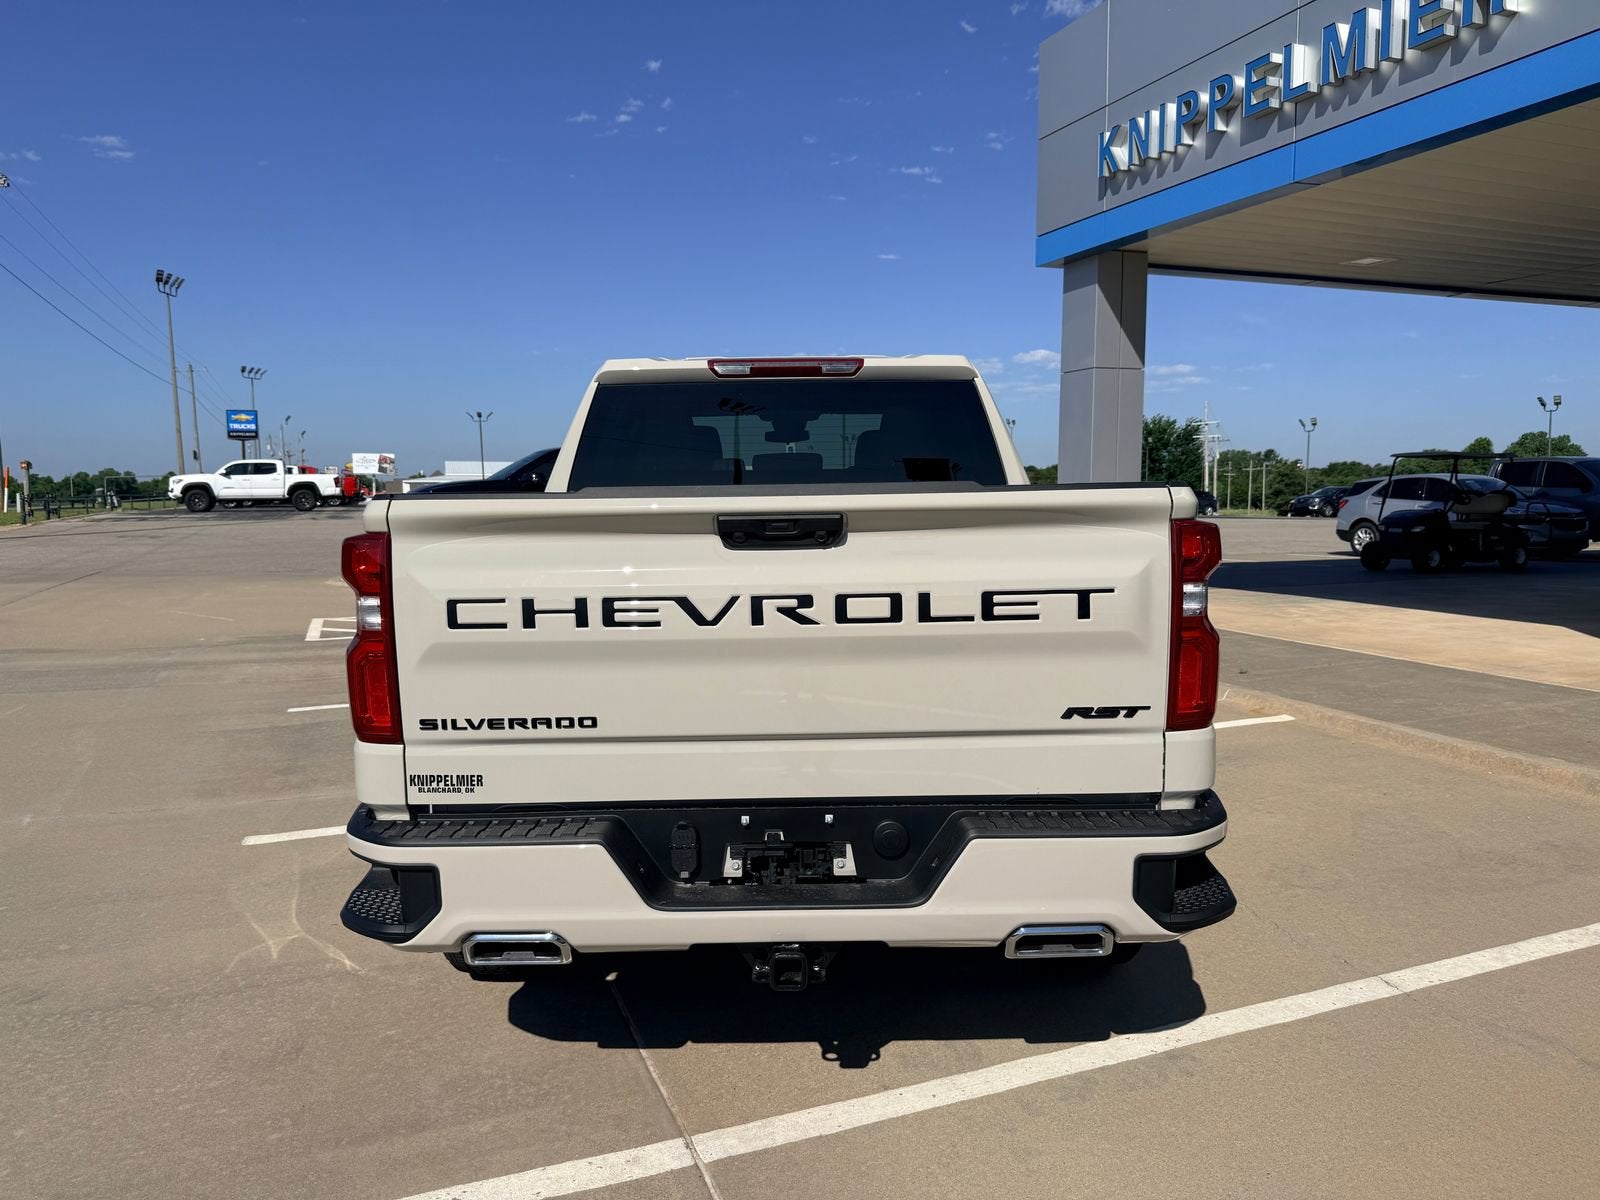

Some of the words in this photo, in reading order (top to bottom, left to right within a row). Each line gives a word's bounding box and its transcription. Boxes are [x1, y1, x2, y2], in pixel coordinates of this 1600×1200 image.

[1098, 0, 1518, 178] KNIPPELMIE
[446, 588, 1115, 629] CHEVROLET
[1060, 706, 1151, 719] RST
[419, 716, 598, 731] SILVERADO
[409, 774, 484, 787] KNIPPELMIER
